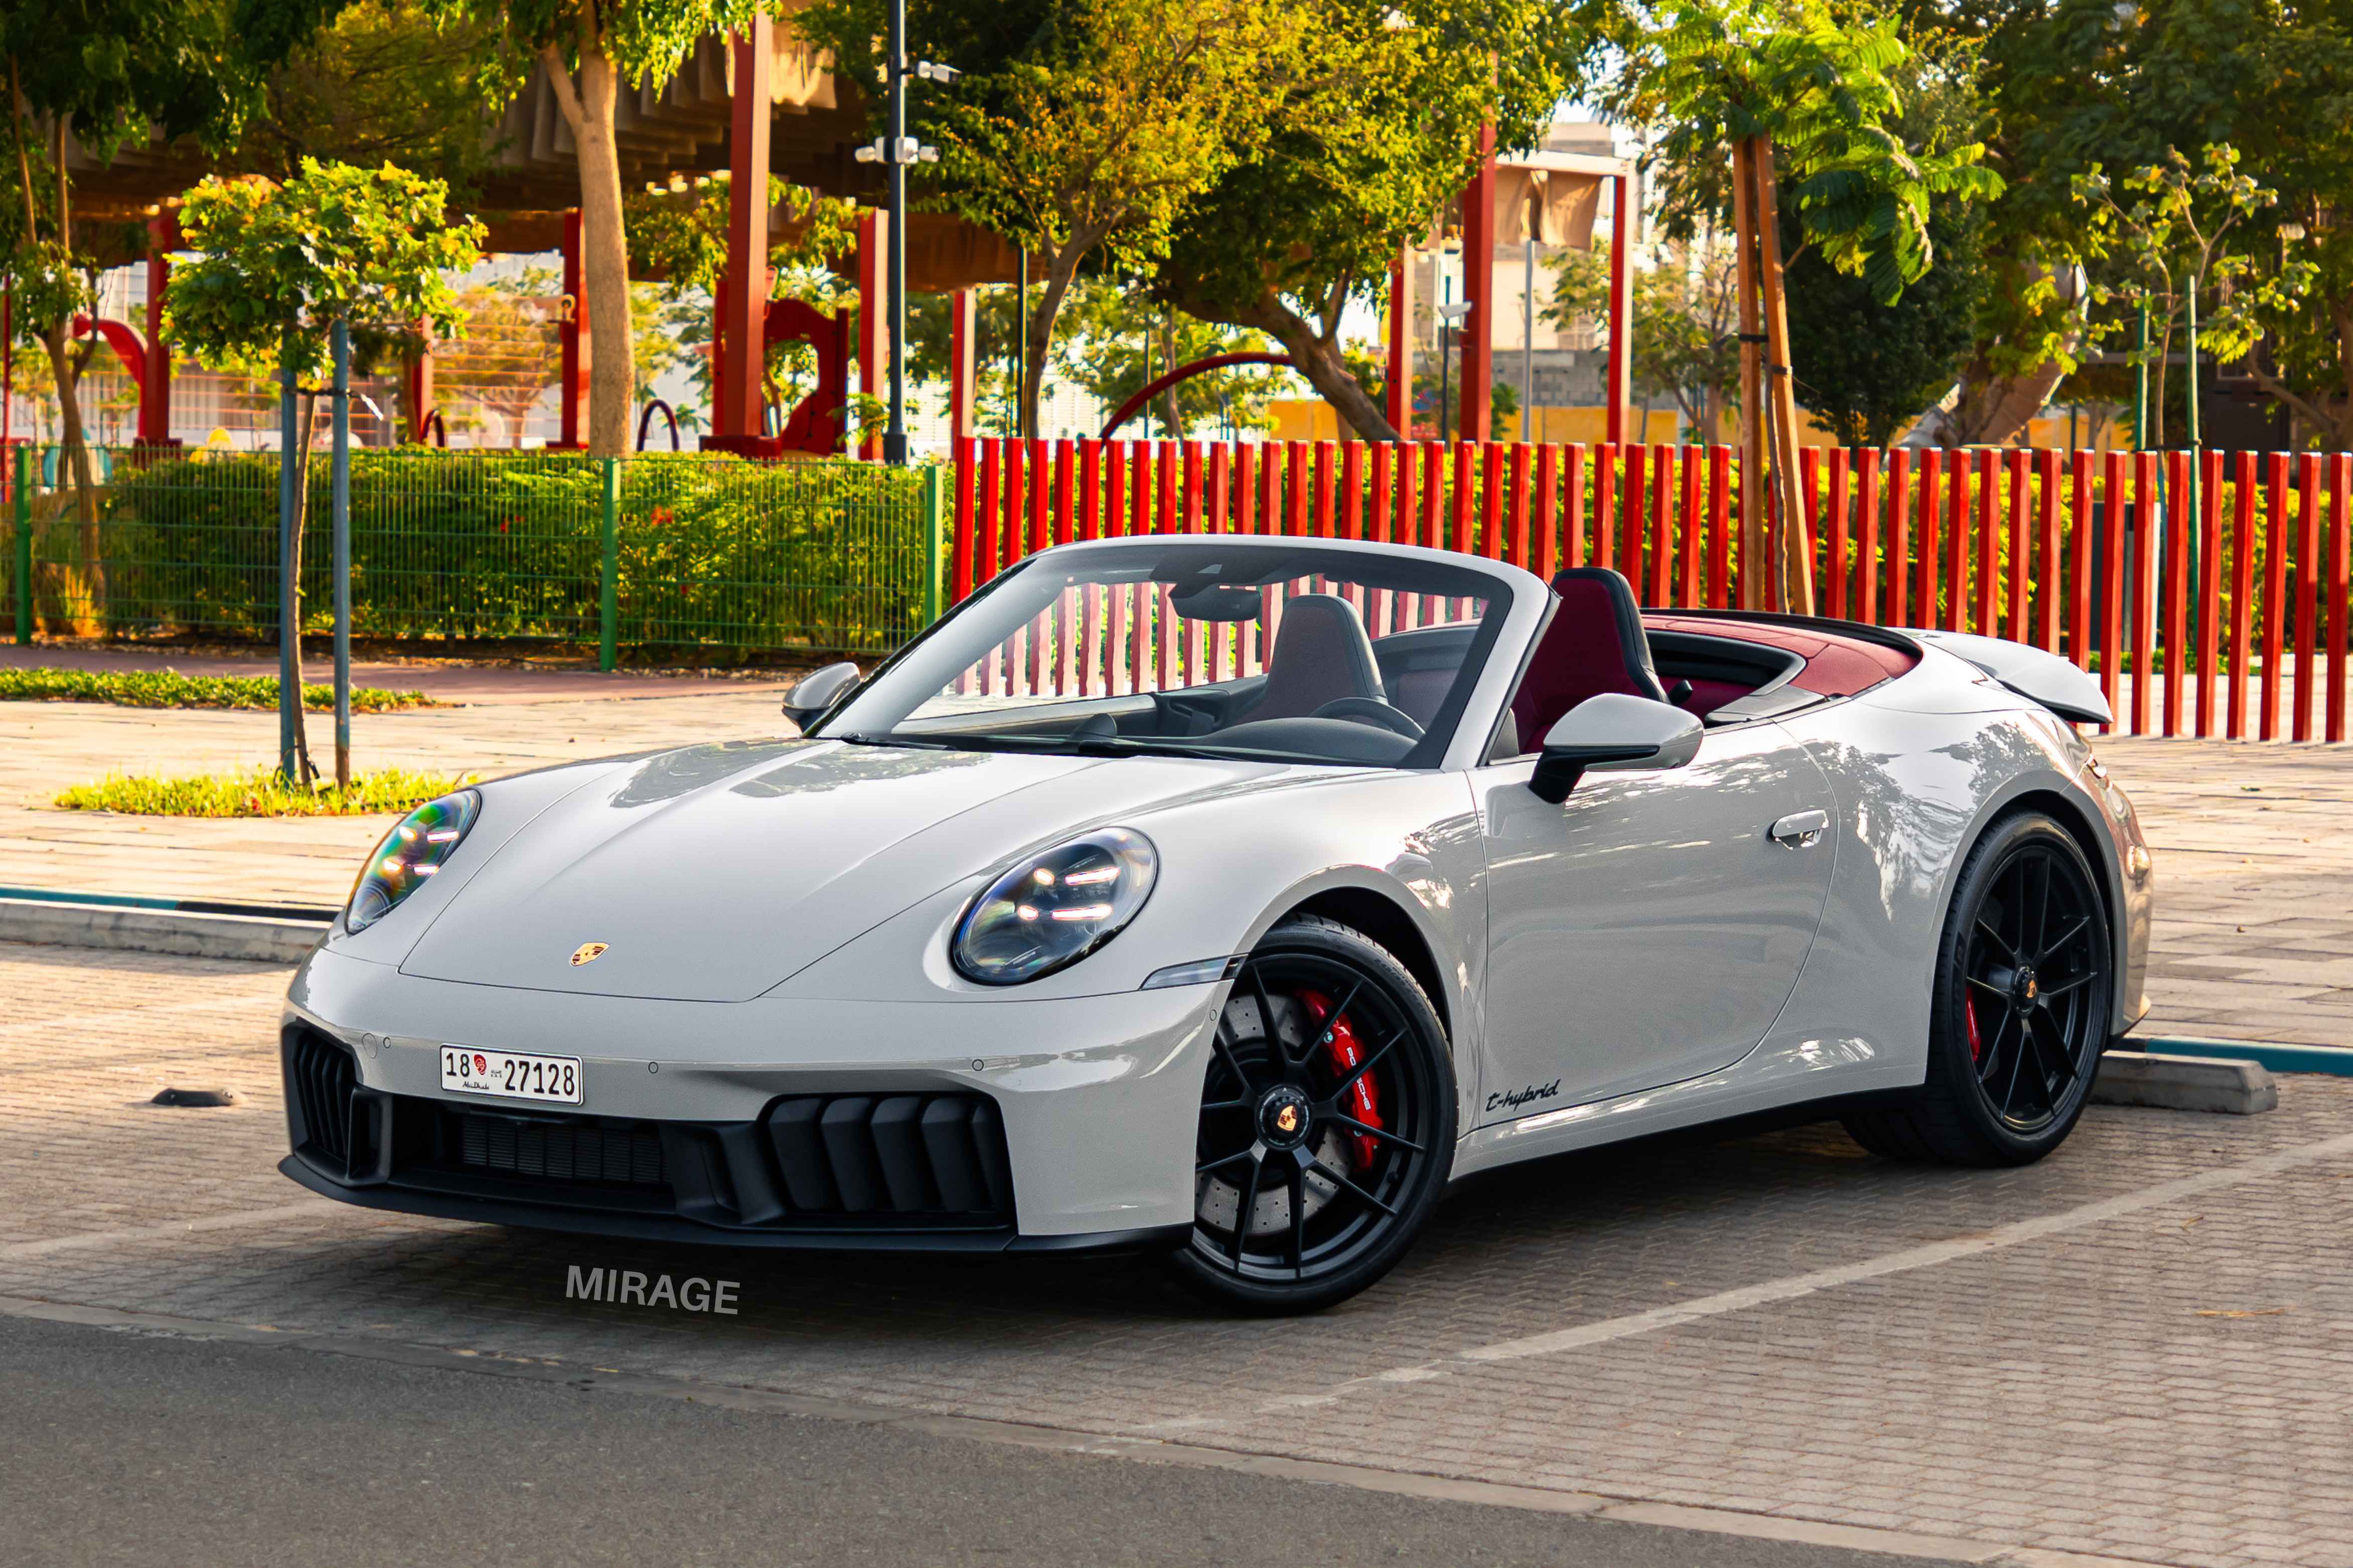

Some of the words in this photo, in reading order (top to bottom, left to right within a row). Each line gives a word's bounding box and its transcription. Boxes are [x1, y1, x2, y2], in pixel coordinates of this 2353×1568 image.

[446, 1052, 470, 1078] 18
[504, 1059, 575, 1096] 27128
[1346, 1046, 1371, 1110] POSCHE
[1486, 1078, 1561, 1112] t-hybrid
